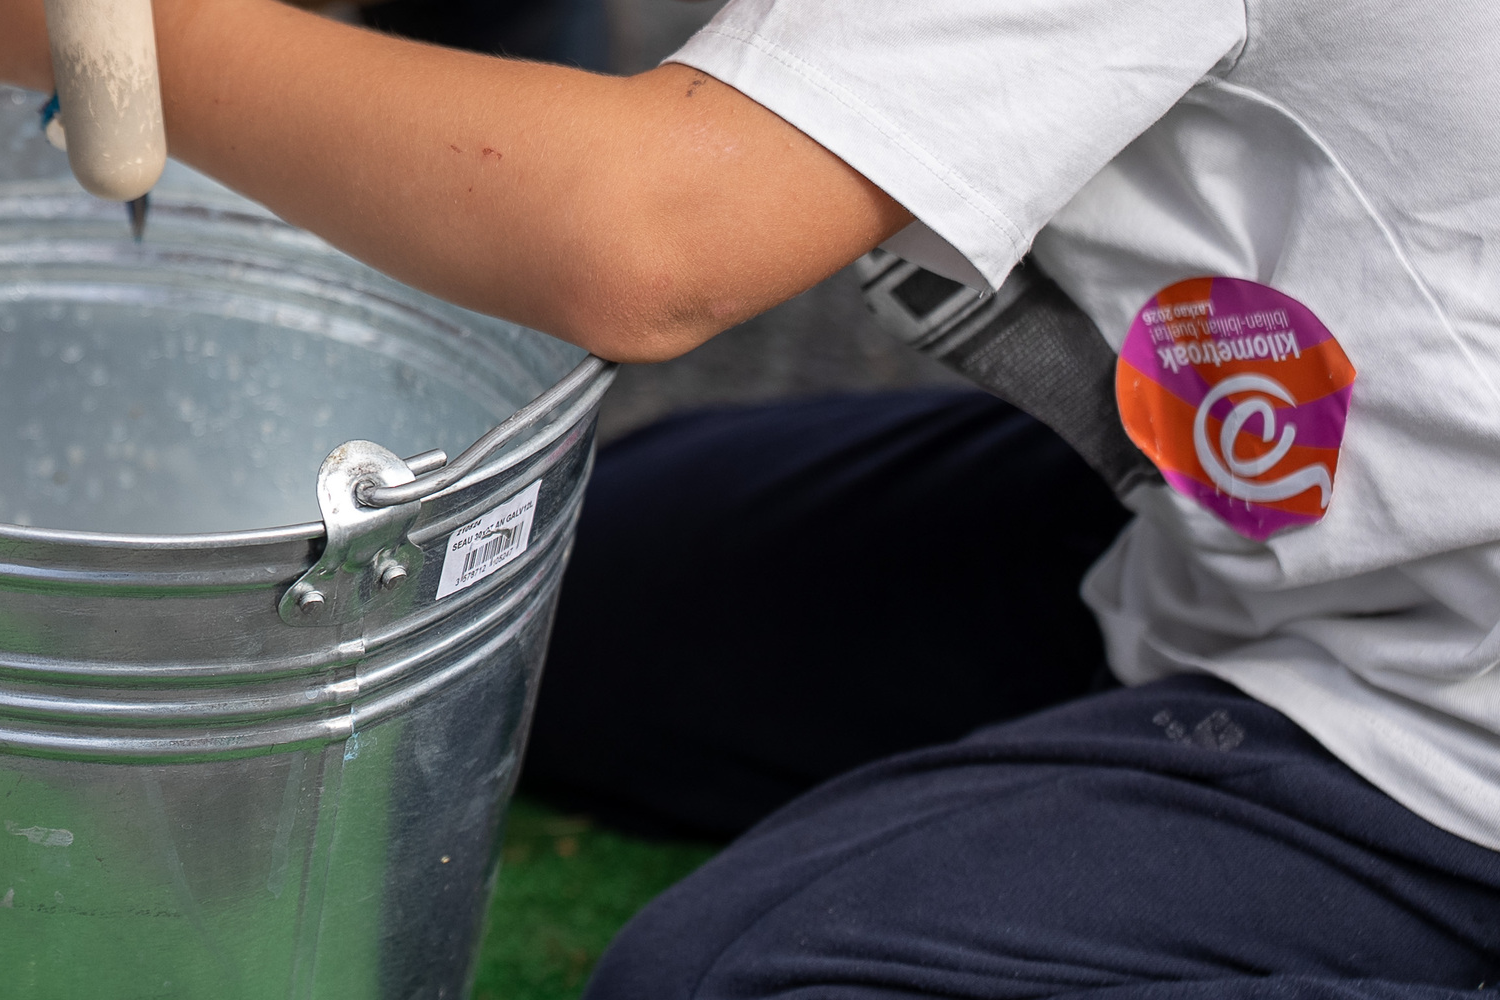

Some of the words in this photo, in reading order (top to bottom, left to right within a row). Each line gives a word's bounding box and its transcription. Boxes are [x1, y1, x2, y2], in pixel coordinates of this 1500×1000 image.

[1142, 308, 1173, 326] 2026
[1174, 300, 1215, 319] Lazkao
[1149, 318, 1197, 345] buelta!
[1157, 330, 1300, 374] kilometroak
[452, 536, 474, 552] SEAU
[494, 518, 506, 529] AN
